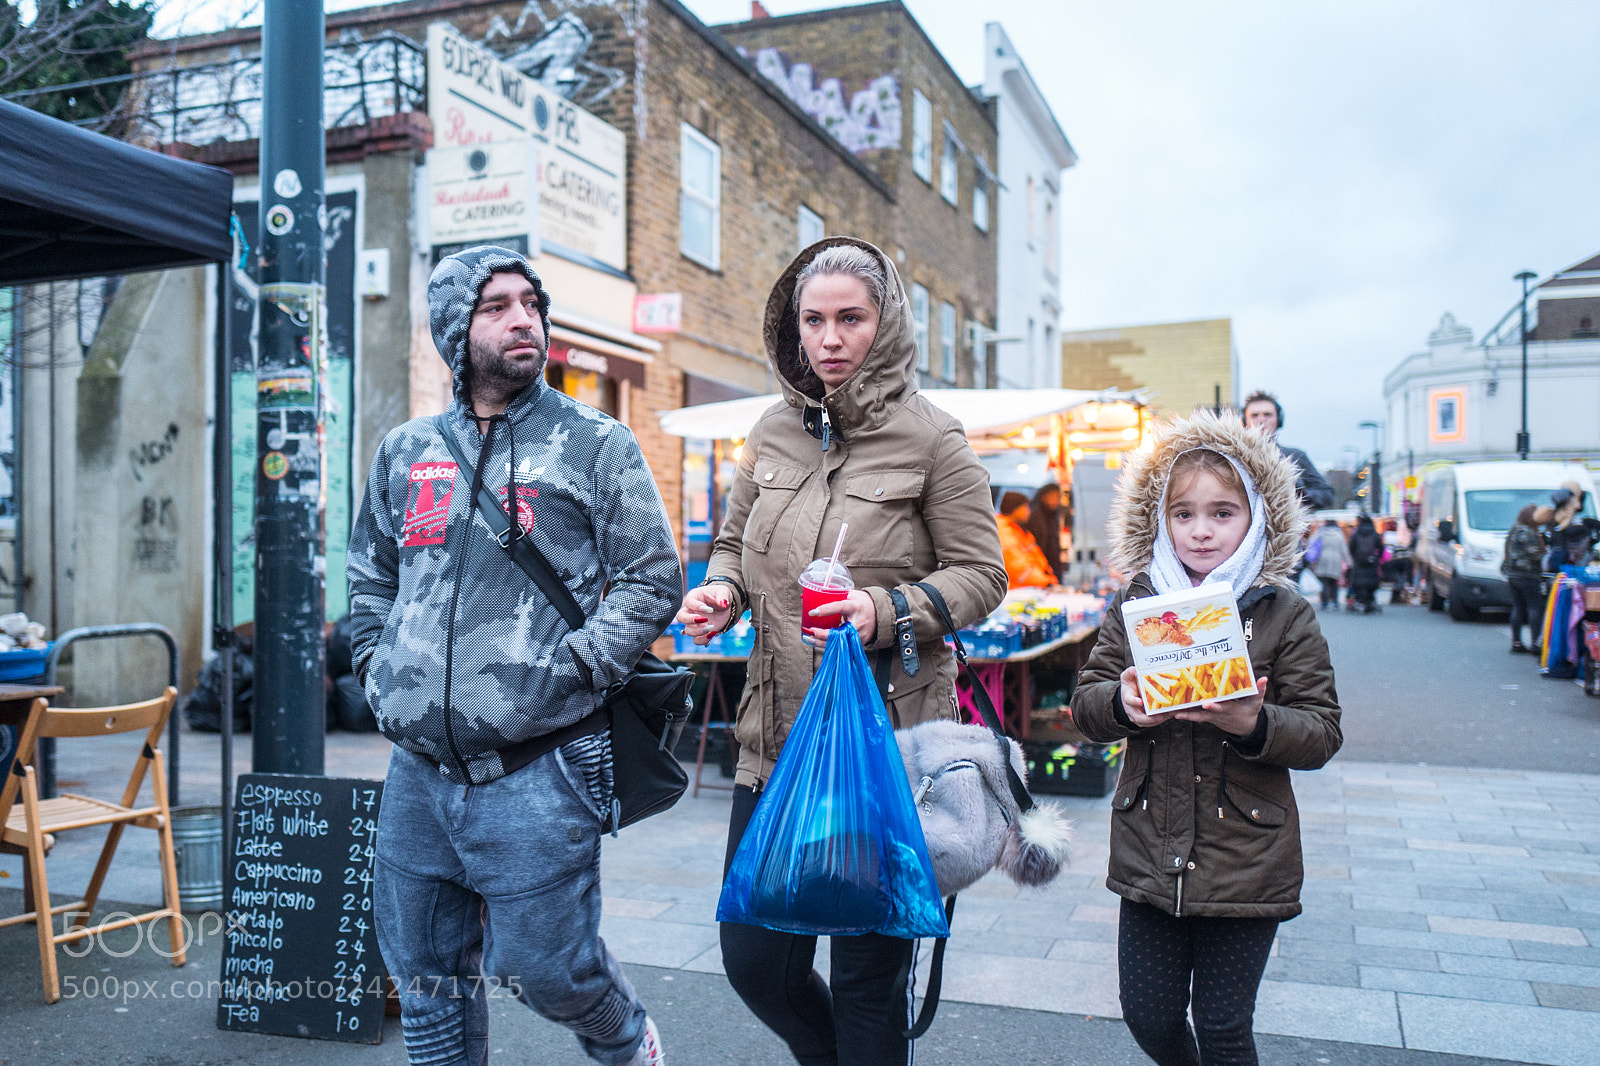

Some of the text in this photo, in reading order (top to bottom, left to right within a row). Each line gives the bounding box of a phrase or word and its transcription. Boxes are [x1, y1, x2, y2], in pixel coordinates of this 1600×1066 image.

[453, 200, 525, 223] CATERING
[411, 465, 457, 480] adidas
[499, 484, 539, 498] adas
[1195, 647, 1208, 657] the
[1210, 642, 1232, 654] Taste
[241, 783, 321, 815] espresso
[238, 810, 274, 834] Flat
[283, 808, 328, 837] white
[235, 837, 283, 857] Latte
[235, 861, 322, 888] Cappuccino
[232, 887, 315, 910] Americano
[228, 929, 283, 954] piccolo
[226, 953, 274, 976] mocha
[221, 1003, 260, 1026] Tea
